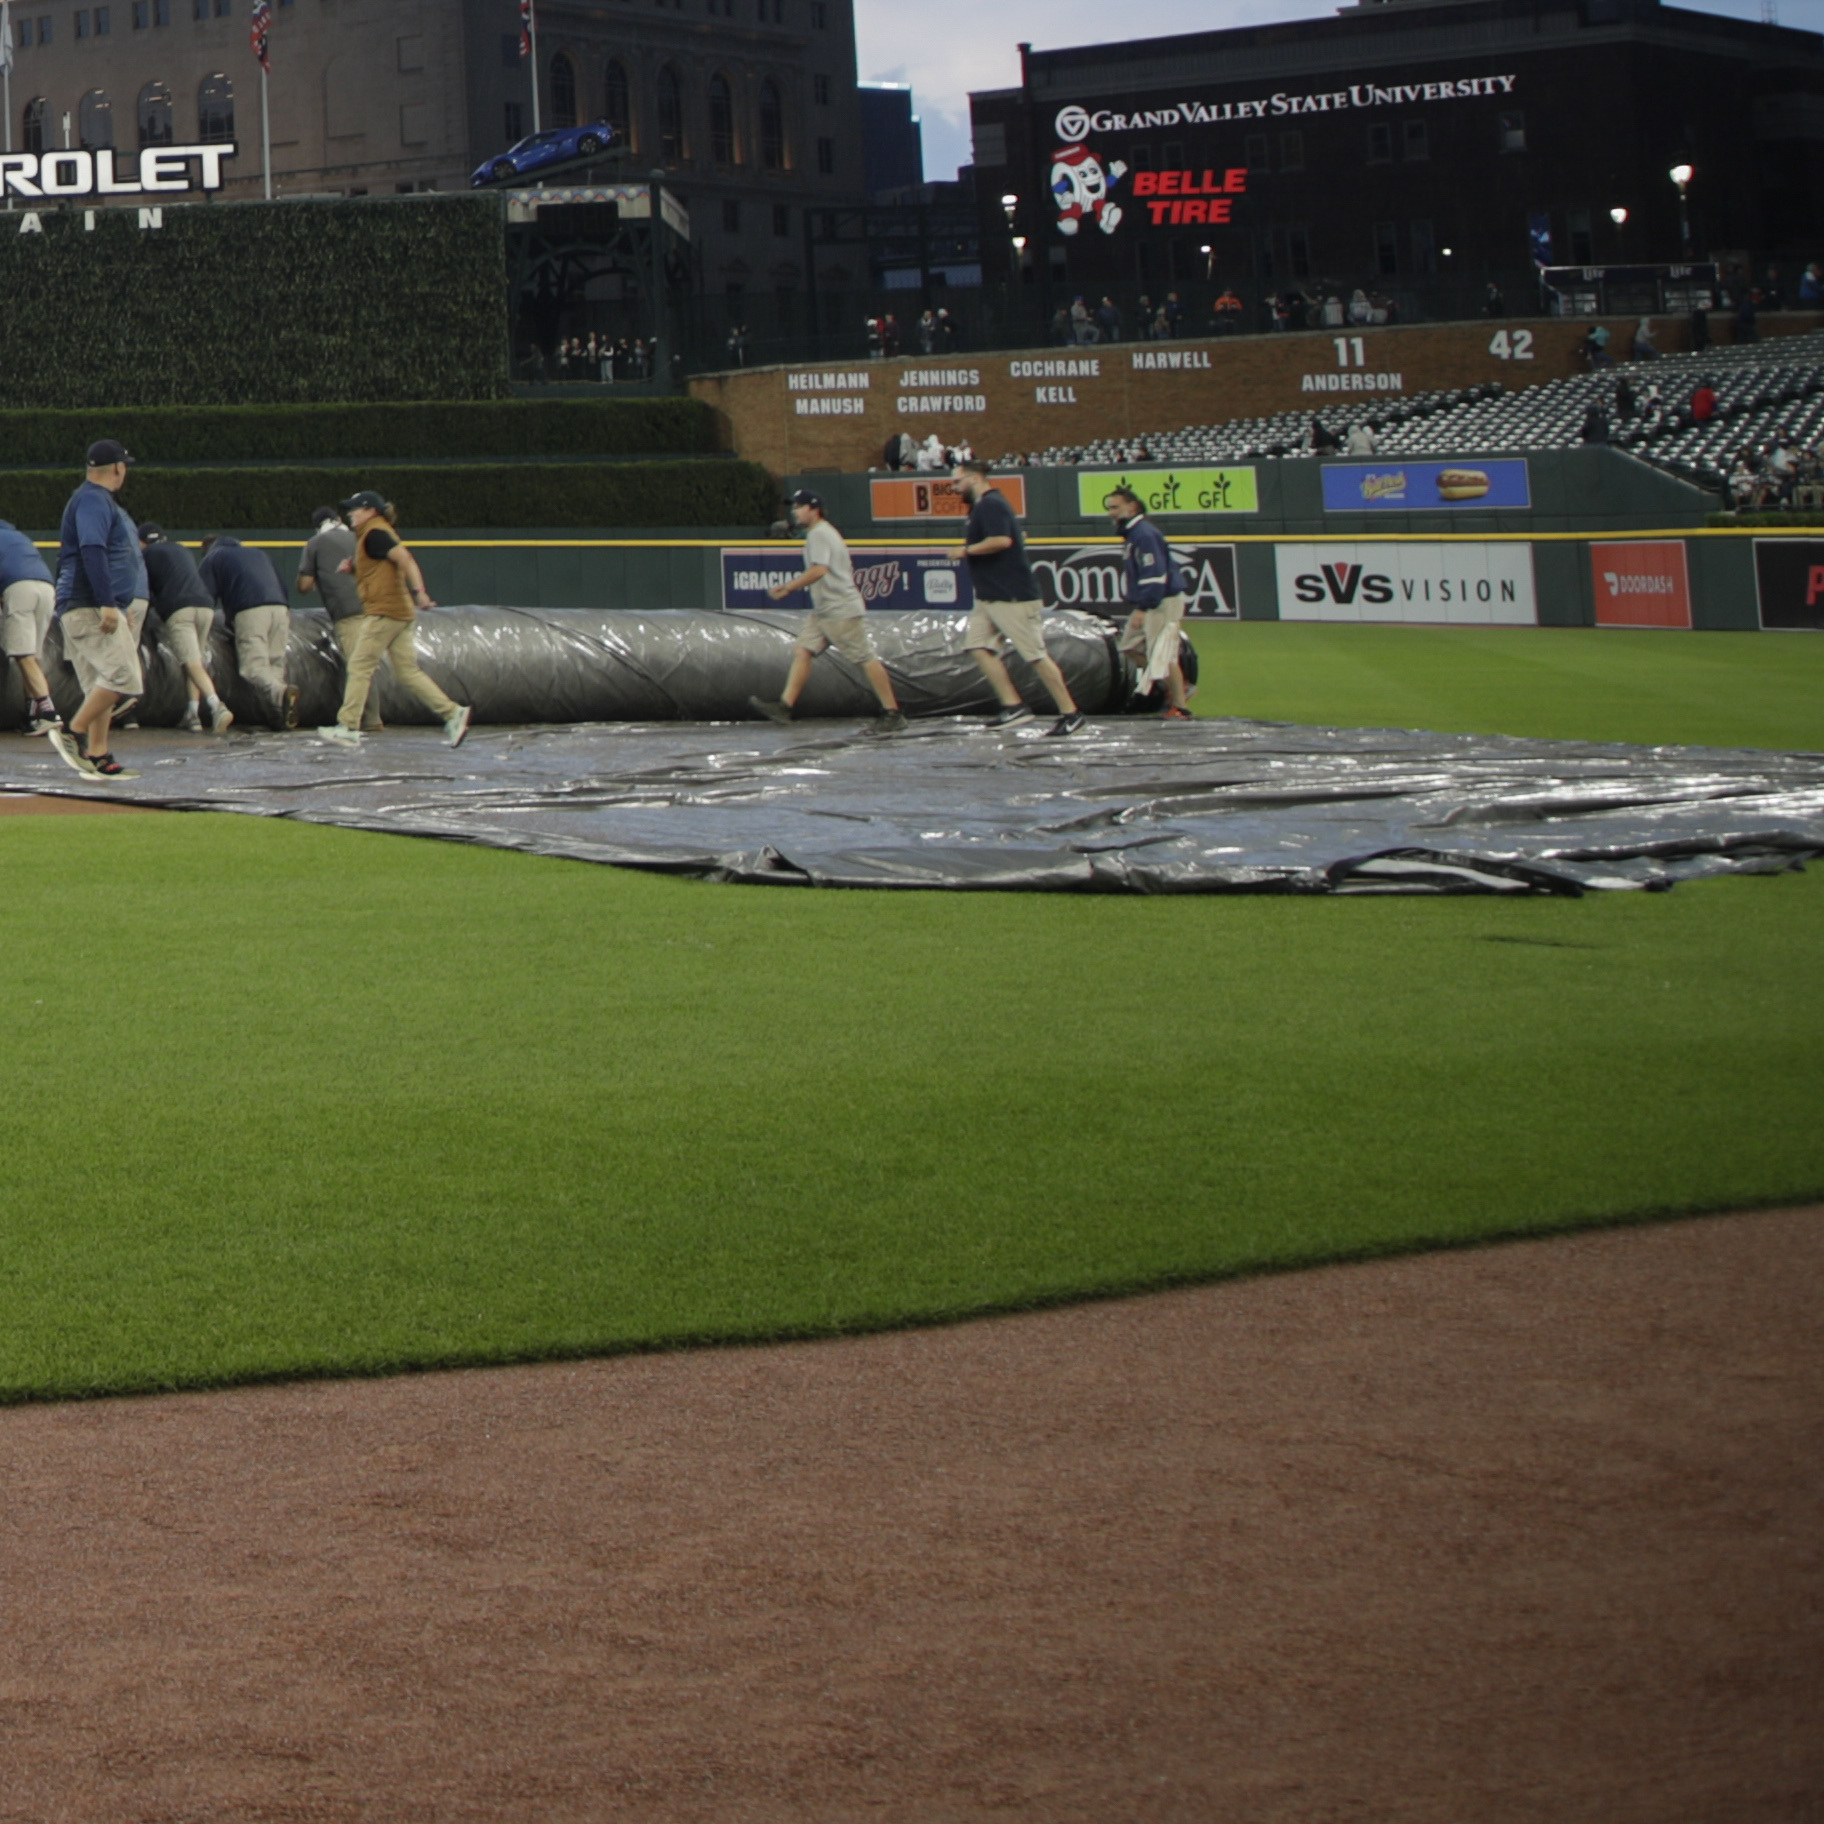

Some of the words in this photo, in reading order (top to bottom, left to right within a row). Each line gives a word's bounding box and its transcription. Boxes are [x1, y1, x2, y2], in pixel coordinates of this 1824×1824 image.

[1090, 107, 1180, 132] GRAND
[1178, 100, 1268, 124] VALLEY
[1270, 92, 1349, 115] STATE
[1349, 74, 1517, 107] UNIVERSITY
[1133, 168, 1249, 197] BELLE
[1147, 198, 1233, 225] TIRE
[1332, 336, 1366, 368] 11
[1489, 329, 1535, 361] 42
[1010, 358, 1100, 378] COCHRANE
[1132, 350, 1213, 370] HARWELL
[788, 372, 870, 390] HEILMANN
[899, 369, 981, 388] JENNINGS
[1301, 372, 1403, 393] ANDERSON
[897, 394, 987, 414] CRAWFORD
[1036, 385, 1077, 404] KELL
[795, 397, 865, 415] MANUSH
[1149, 483, 1182, 510] GFL
[1198, 481, 1233, 509] GFL
[1401, 578, 1517, 603] VISION
[1619, 576, 1675, 595] DOORDASH
